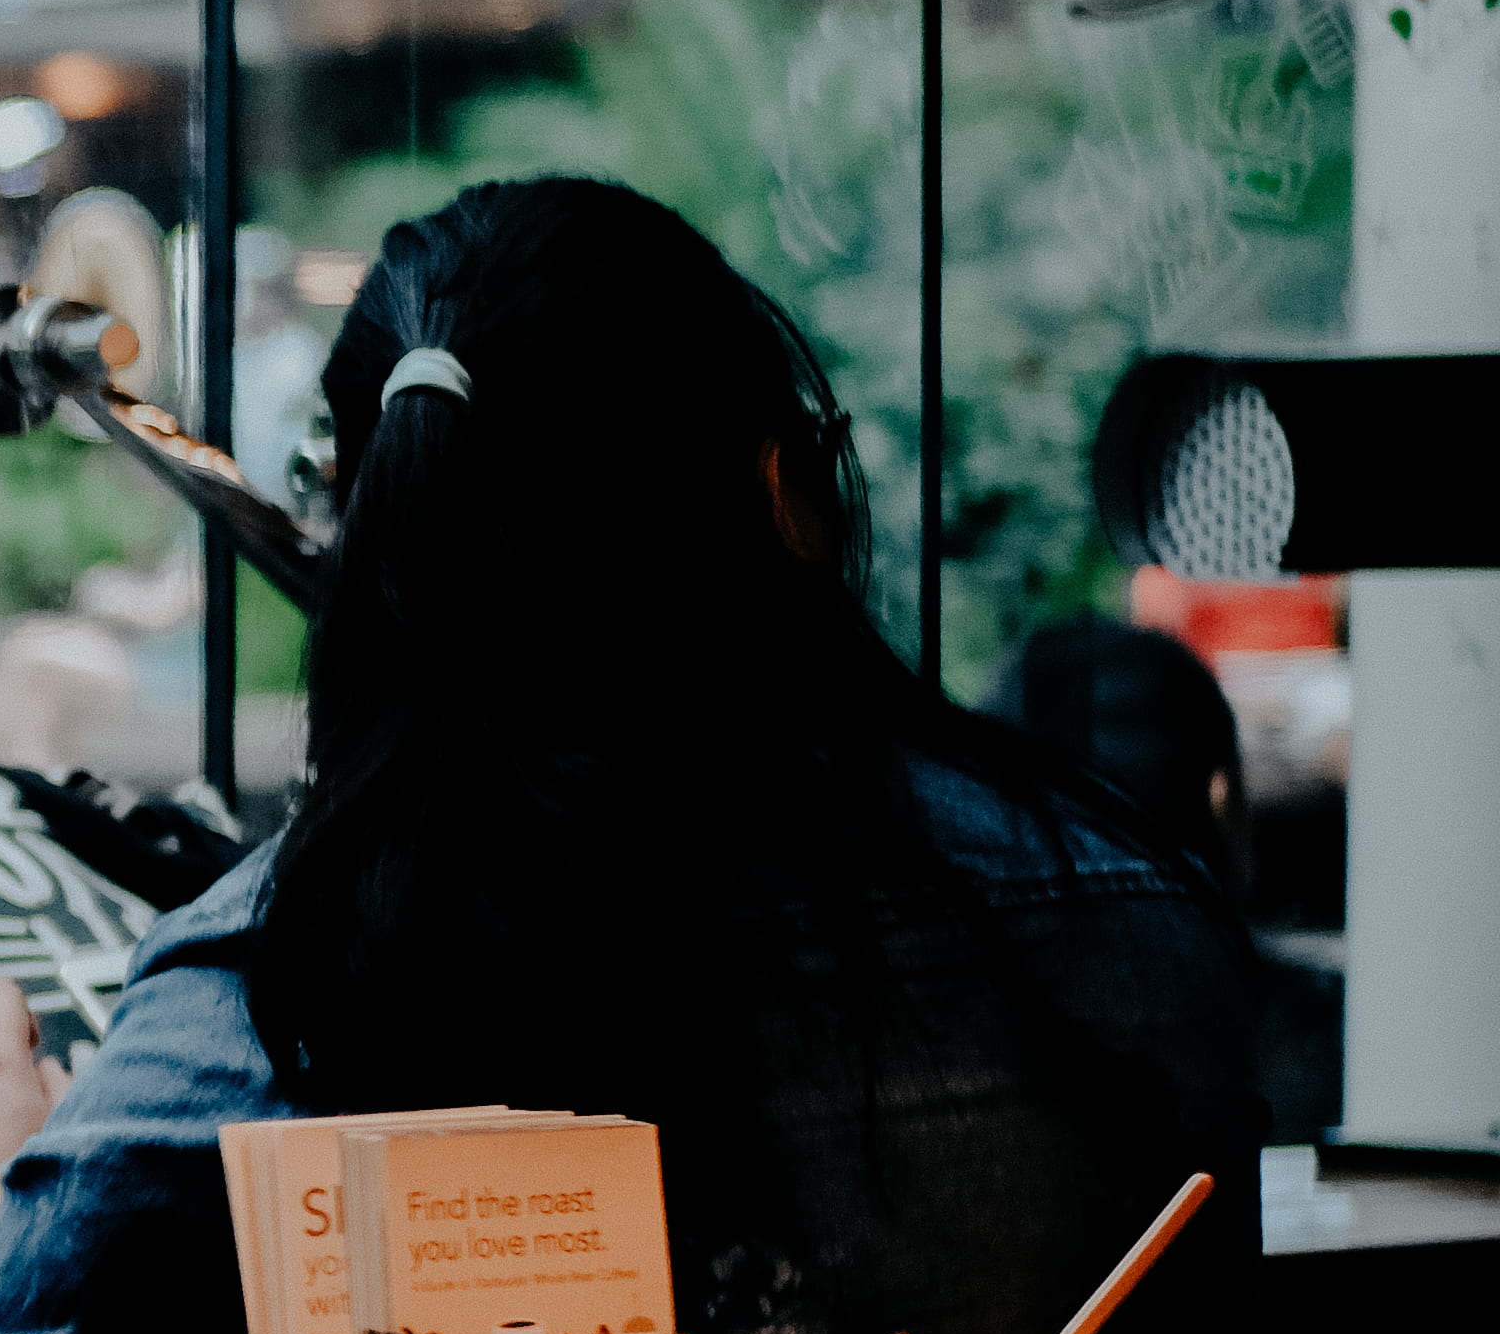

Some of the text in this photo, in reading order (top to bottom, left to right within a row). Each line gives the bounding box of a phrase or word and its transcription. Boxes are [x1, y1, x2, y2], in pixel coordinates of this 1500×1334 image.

[406, 1185, 596, 1222] Find the roast
[407, 1226, 608, 1273] you love most.
[302, 1254, 350, 1287] yo
